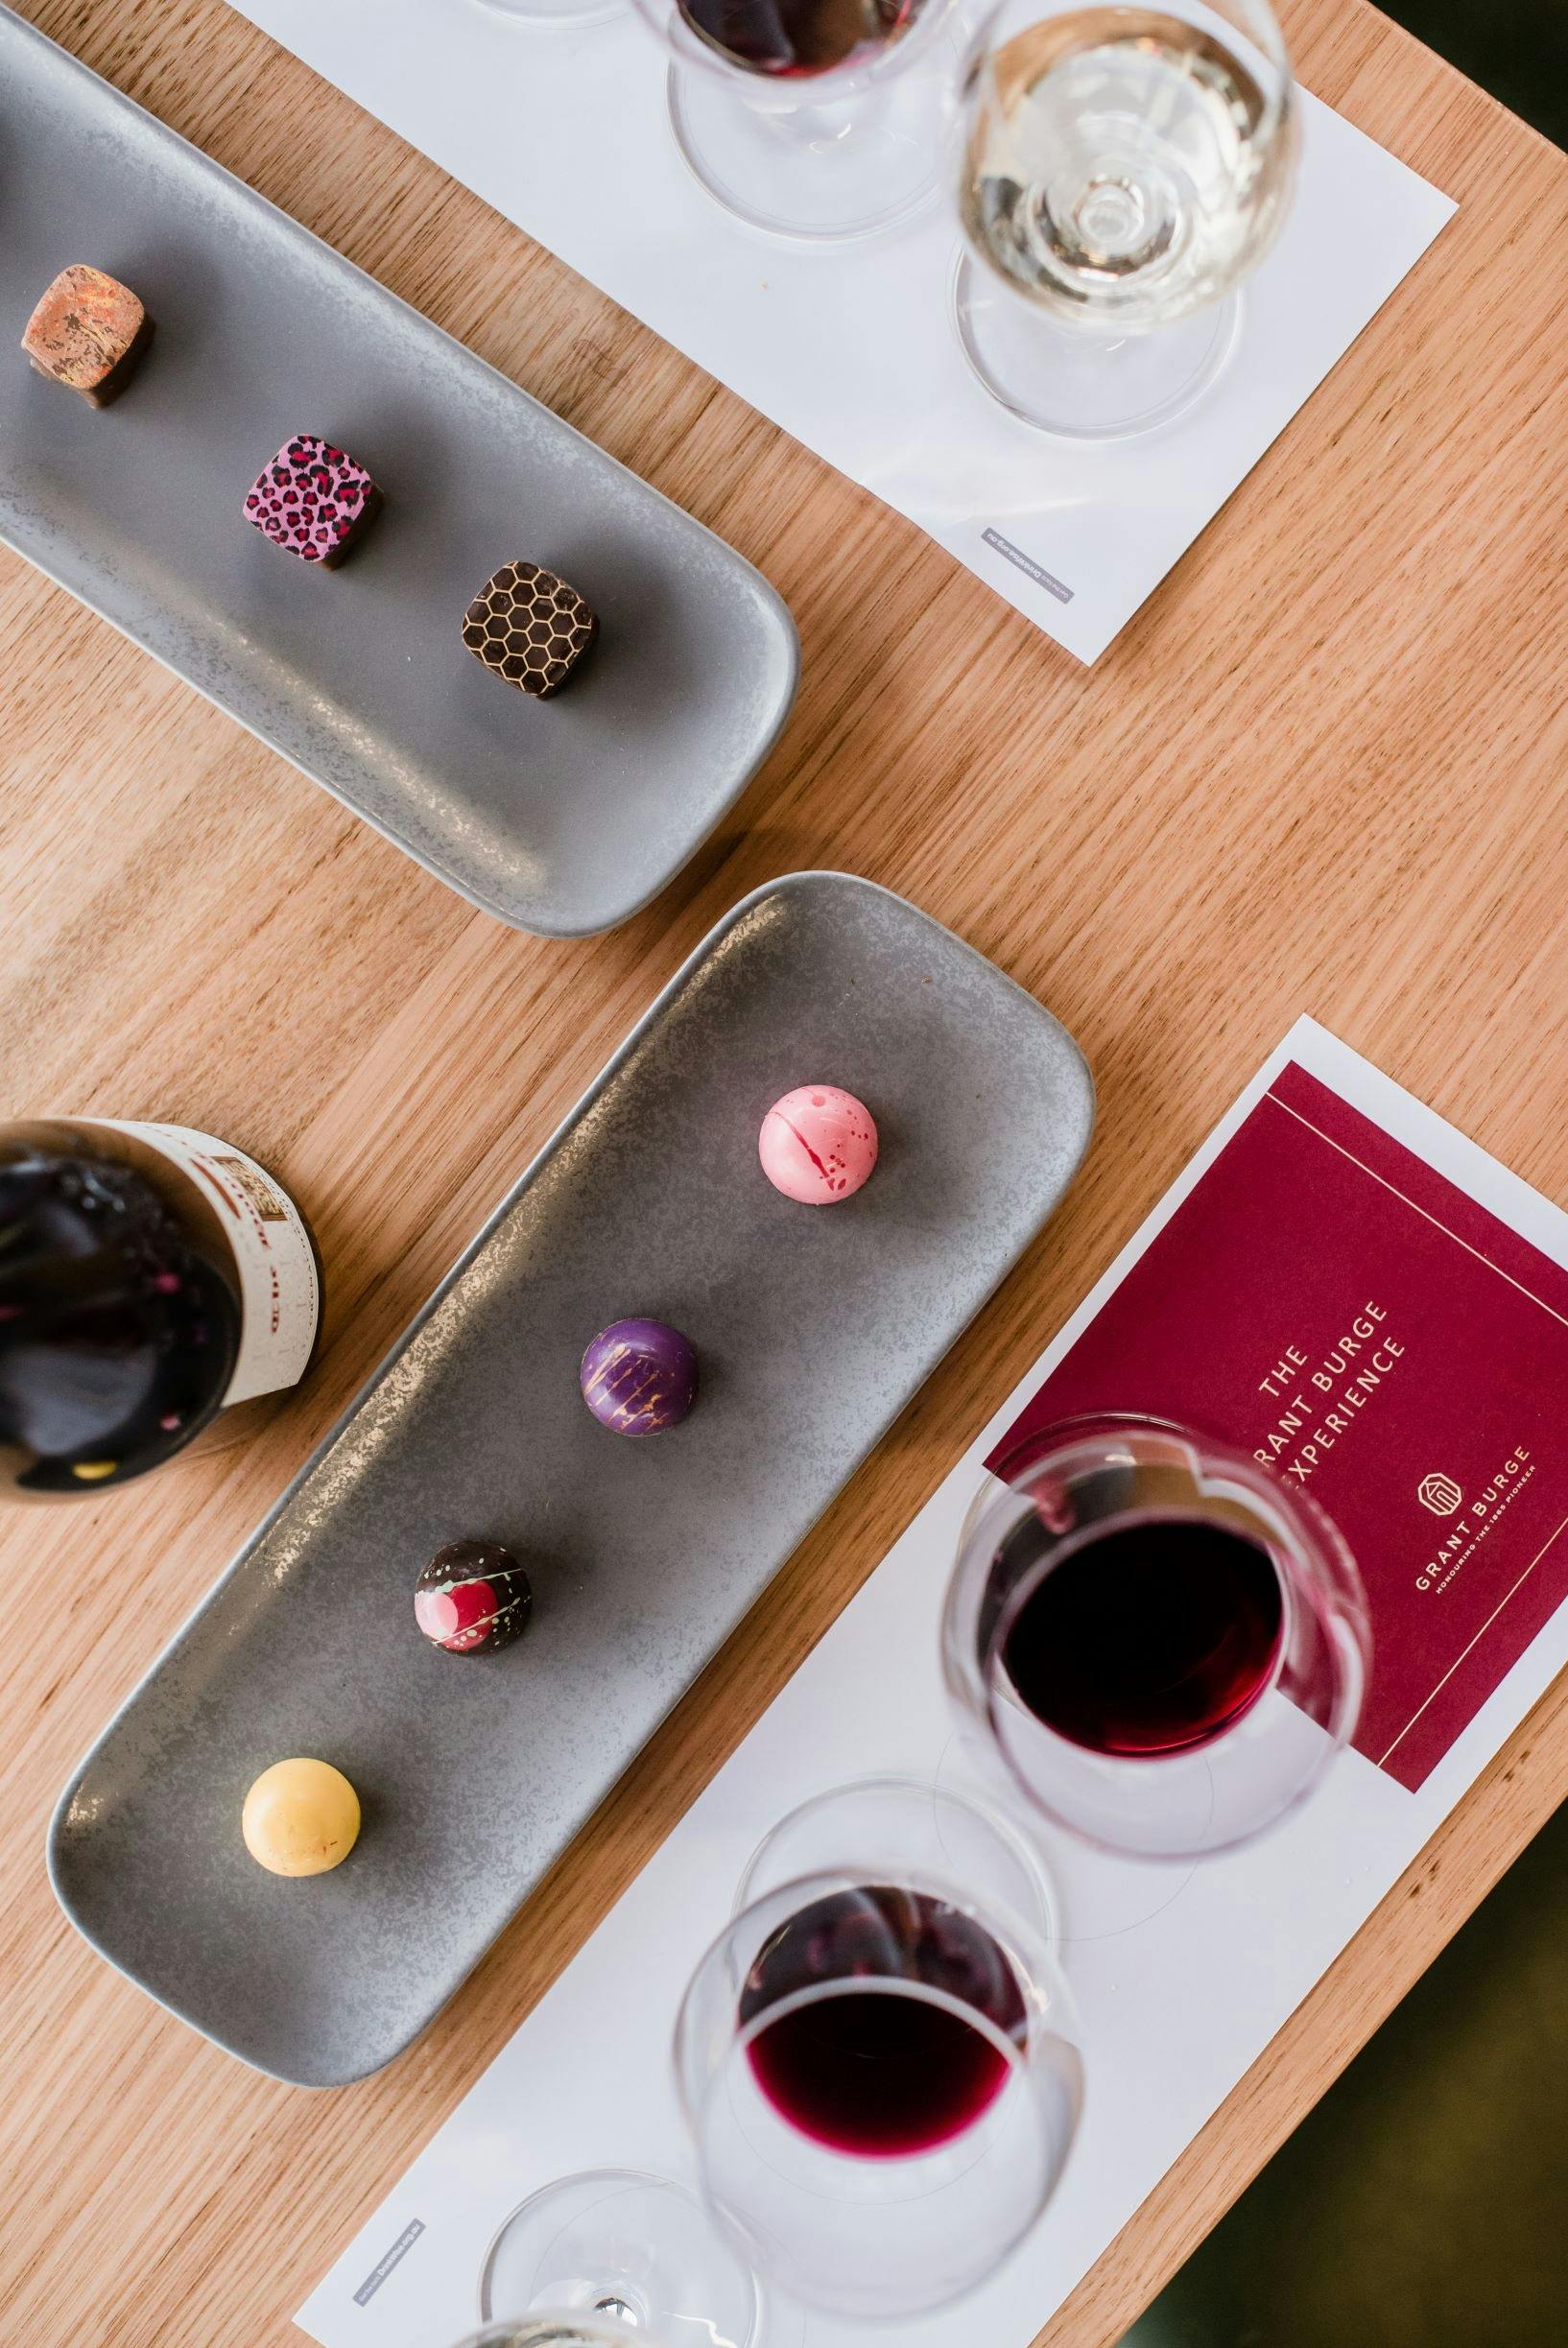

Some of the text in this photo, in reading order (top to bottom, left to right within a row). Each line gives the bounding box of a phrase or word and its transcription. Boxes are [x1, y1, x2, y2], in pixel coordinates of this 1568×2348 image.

[1253, 1301, 1387, 1469] RANT BURGE
[1259, 1345, 1307, 1396] THE
[1415, 1446, 1530, 1590] GRANT BURGE
[1436, 1544, 1475, 1594] HONOURING
[1476, 1525, 1490, 1543] THE
[1506, 1465, 1536, 1504] PIONEER
